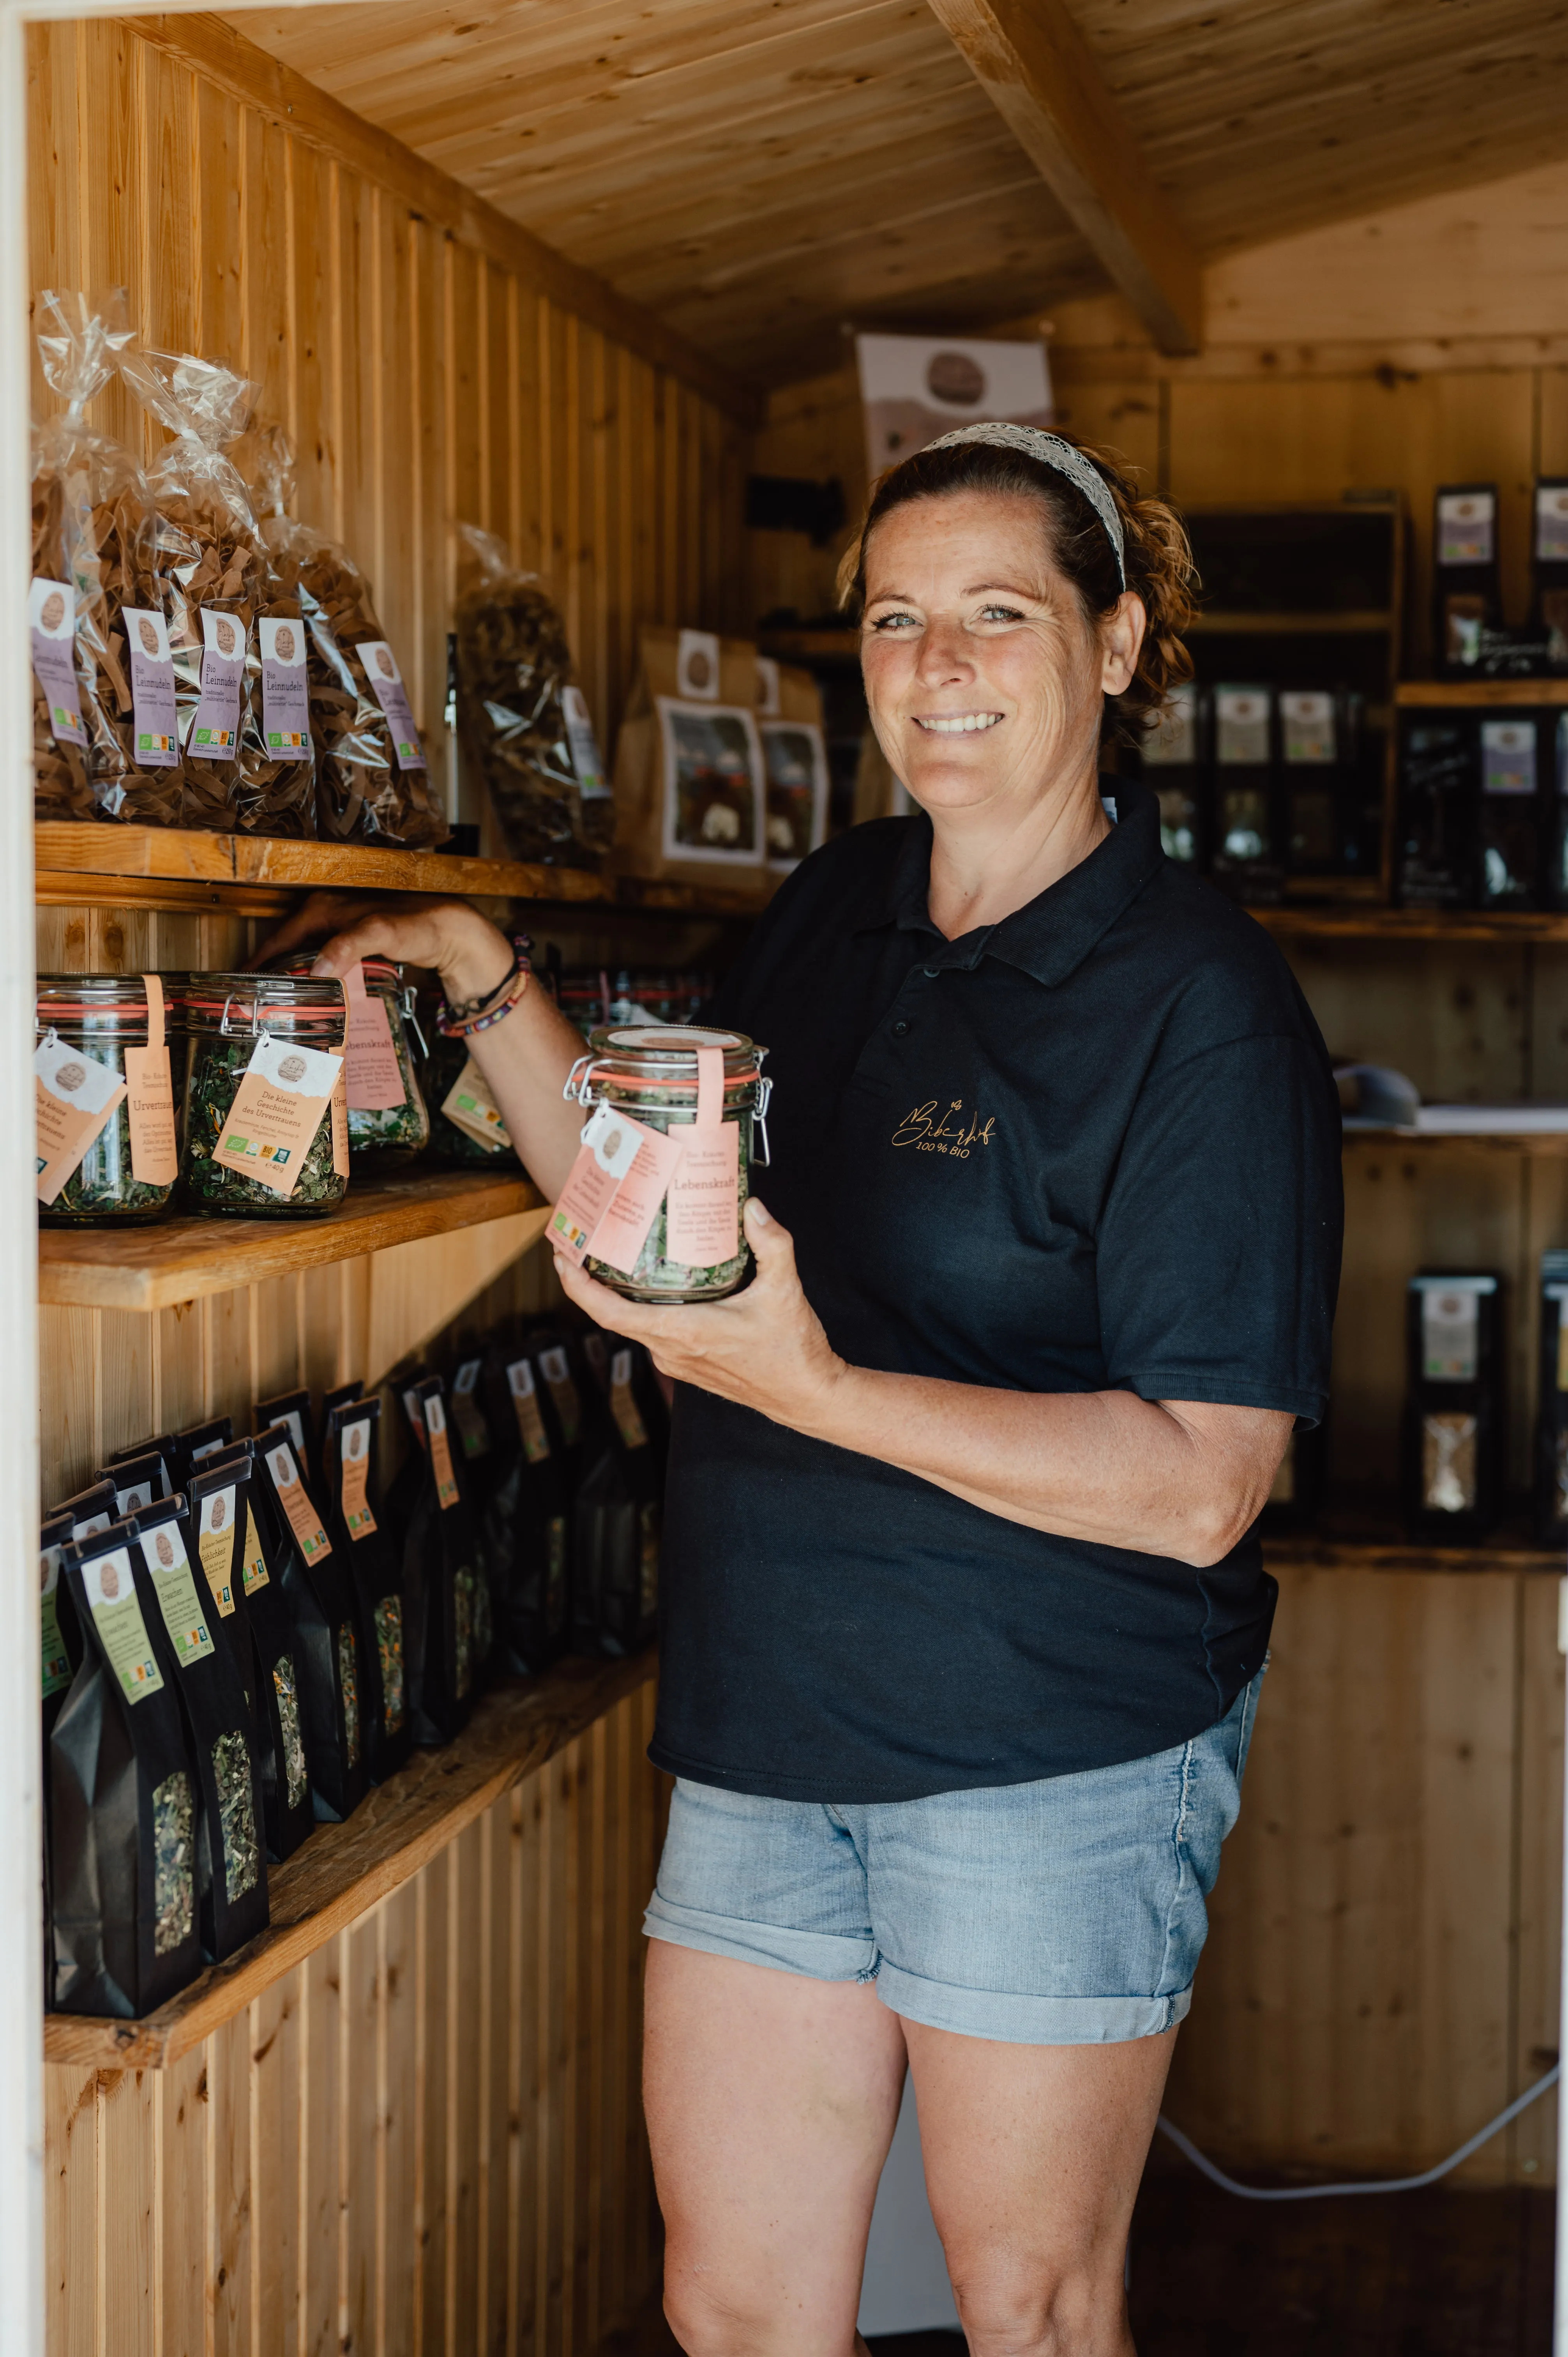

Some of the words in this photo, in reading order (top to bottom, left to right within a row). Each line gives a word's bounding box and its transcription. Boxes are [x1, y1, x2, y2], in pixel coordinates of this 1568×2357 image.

[206, 664, 216, 673] Bio
[267, 671, 275, 679] Bio
[136, 675, 171, 690] Leinnudeln
[205, 673, 237, 687] Leinnudeln
[267, 680, 303, 691] Leinnudeln
[345, 1039, 391, 1050] ebenskraft
[262, 1091, 274, 1100] Die
[275, 1095, 297, 1106] kleine
[132, 1100, 173, 1111] Urvertraue
[257, 1100, 295, 1115] Geschichte
[242, 1106, 254, 1115] des
[256, 1109, 301, 1127] Urvertrauens
[262, 1146, 273, 1154] BIO
[949, 1146, 970, 1158] BIO
[674, 1175, 735, 1190] Lebenskraft
[201, 1547, 226, 1564] Fröhlichkeit
